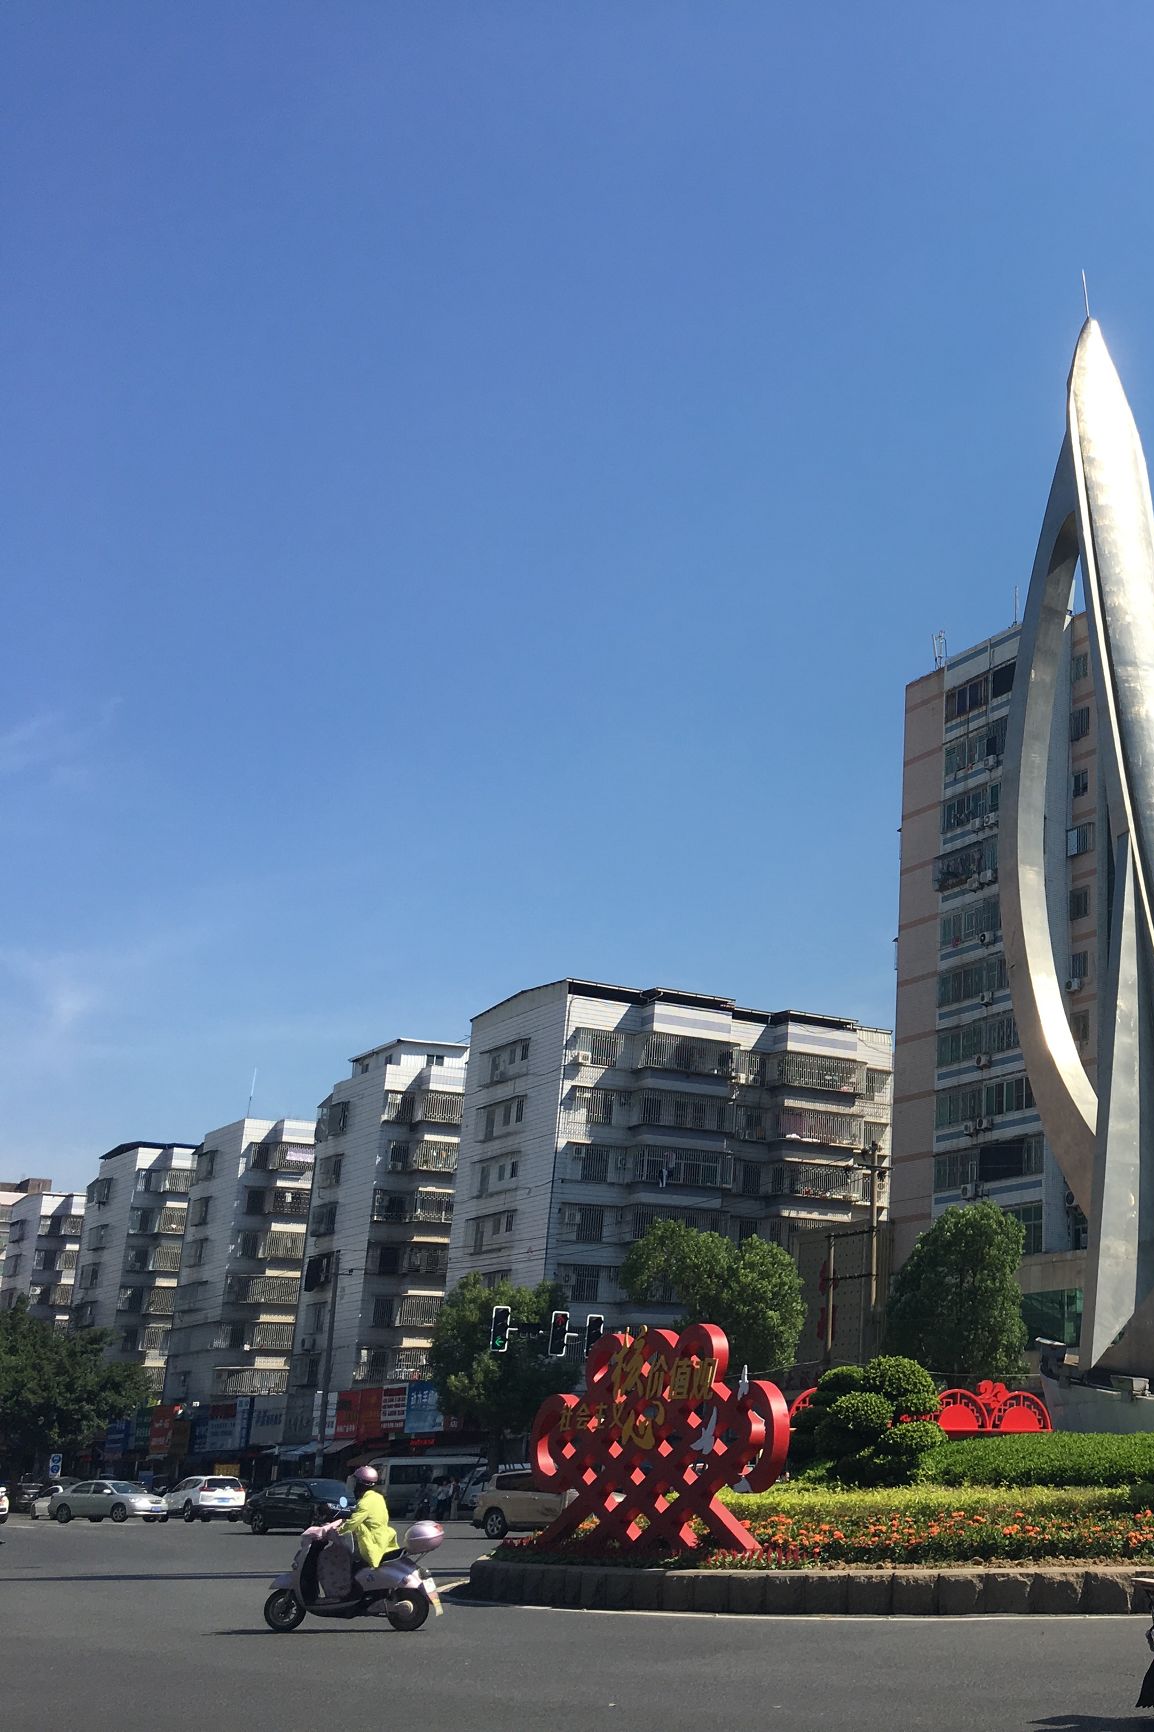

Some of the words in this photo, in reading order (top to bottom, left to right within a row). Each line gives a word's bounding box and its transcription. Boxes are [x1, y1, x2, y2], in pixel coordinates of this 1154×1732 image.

[643, 1350, 719, 1400] 价值观
[558, 1402, 626, 1433] 社会主义
